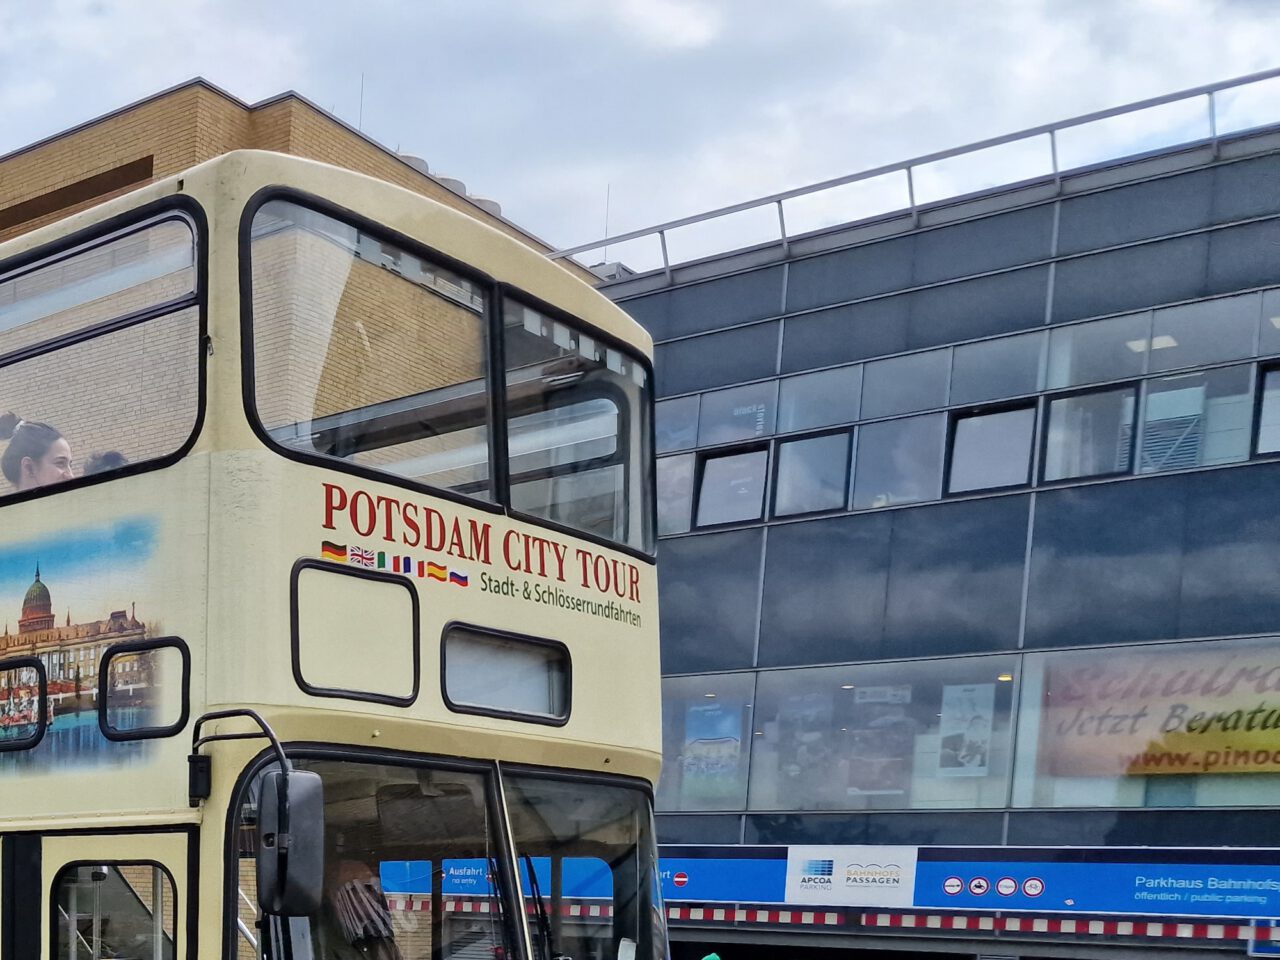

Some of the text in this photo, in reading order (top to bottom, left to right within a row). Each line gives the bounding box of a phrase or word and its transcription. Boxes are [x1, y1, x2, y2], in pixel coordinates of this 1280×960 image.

[321, 483, 641, 603] POTSDAM CITY TOUR
[480, 571, 642, 628] Stadt- & Schlösserrundfahrten
[1056, 705, 1149, 736] Jetzt
[449, 867, 483, 876] Ausfahrt
[1135, 876, 1280, 892] Parkhaus Bahnhofs
